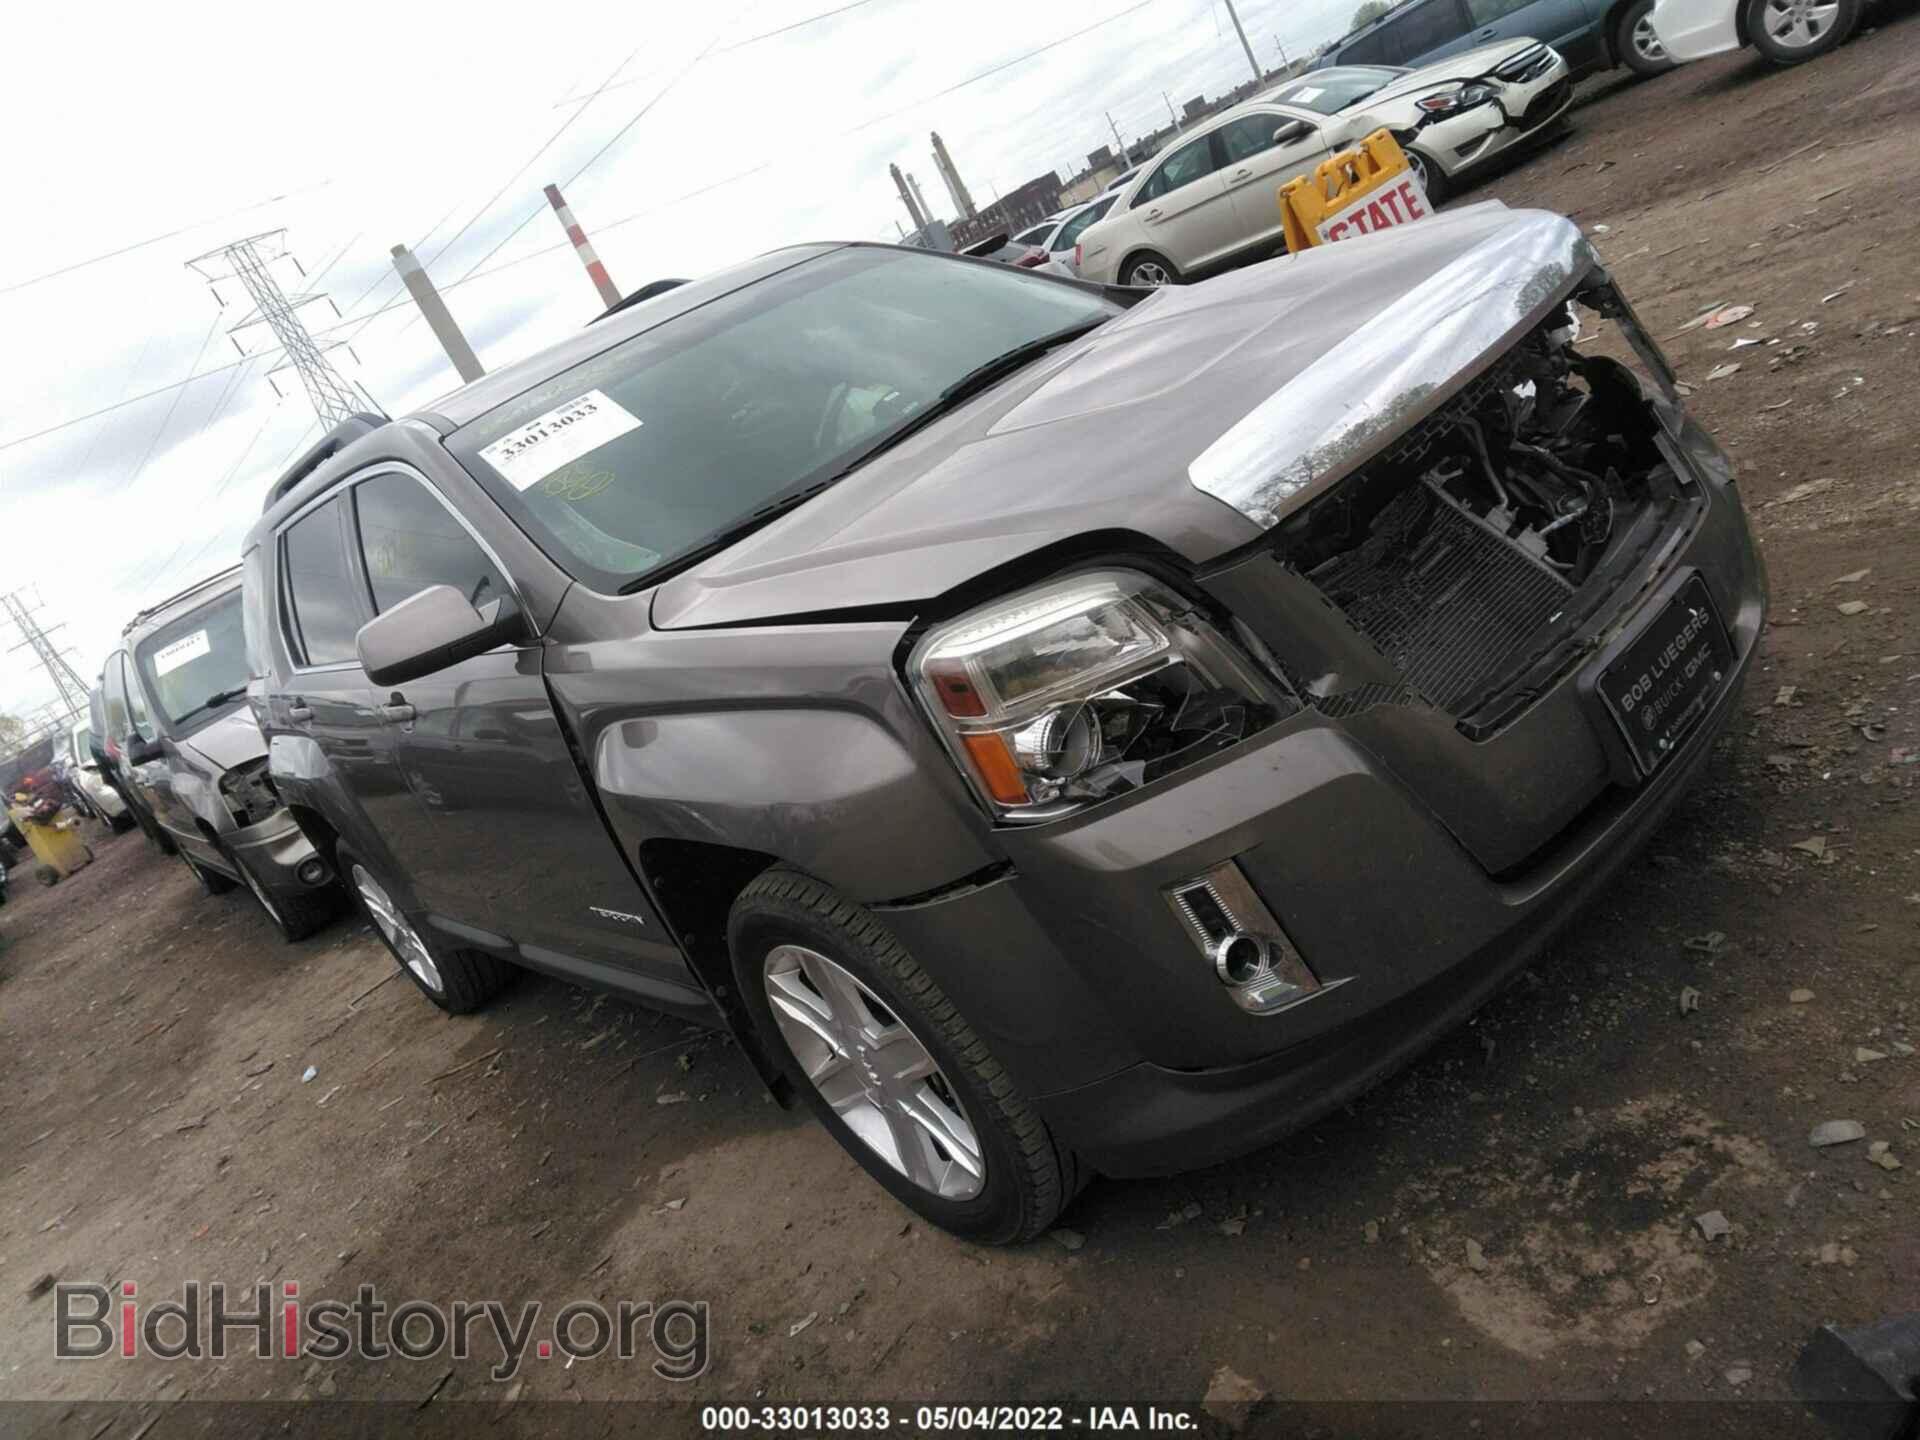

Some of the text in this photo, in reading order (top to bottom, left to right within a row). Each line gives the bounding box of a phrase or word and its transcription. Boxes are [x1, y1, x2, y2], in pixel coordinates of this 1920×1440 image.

[501, 403, 598, 461] 33013033
[1621, 673, 1653, 712] BOB
[1651, 607, 1711, 680] LUEGERS
[1653, 675, 1686, 715] BUICK
[1685, 641, 1712, 679] GMC
